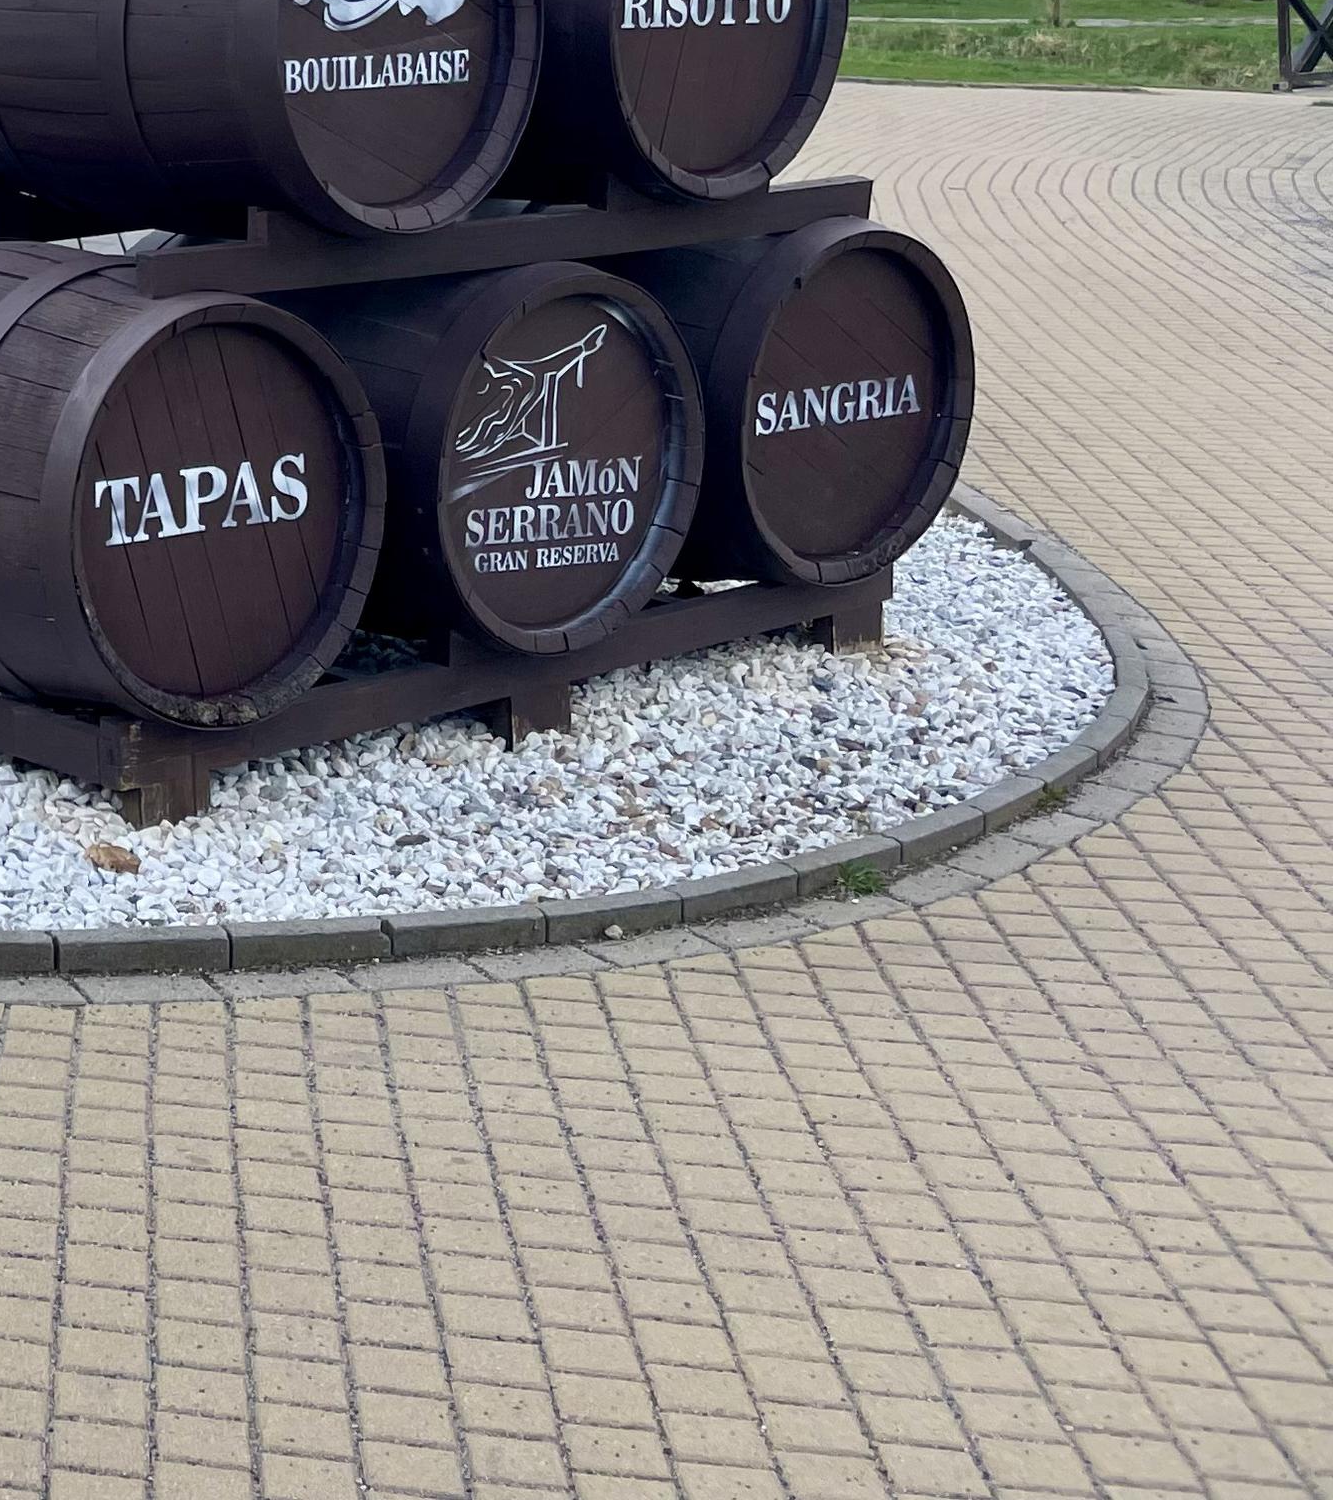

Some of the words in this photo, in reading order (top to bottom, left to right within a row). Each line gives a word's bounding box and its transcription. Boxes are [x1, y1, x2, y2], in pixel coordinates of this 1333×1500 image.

[284, 49, 469, 94] BOUILLABAISE
[755, 374, 921, 437] SANGRIA
[95, 453, 308, 547] TAPAS
[465, 498, 635, 548] SERRANO
[475, 550, 529, 573] GRAN
[536, 542, 620, 568] RESERVA
